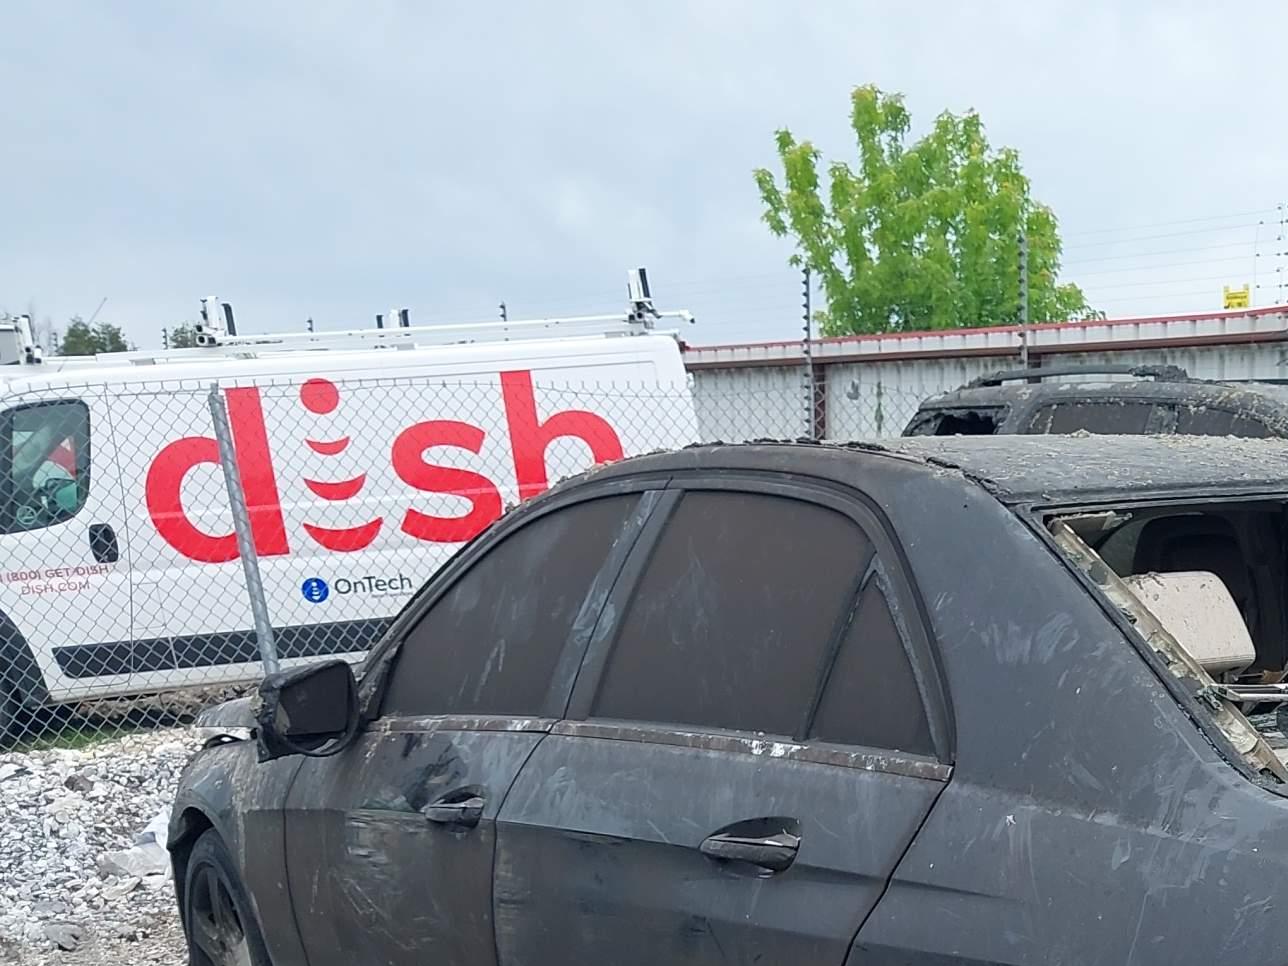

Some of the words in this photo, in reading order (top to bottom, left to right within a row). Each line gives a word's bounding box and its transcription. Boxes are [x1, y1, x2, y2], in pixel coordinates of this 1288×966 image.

[145, 369, 624, 563] dish
[45, 568, 71, 579] GET
[75, 564, 109, 577] DISH
[22, 581, 91, 595] DISH.COM
[334, 573, 413, 595] OnTech
